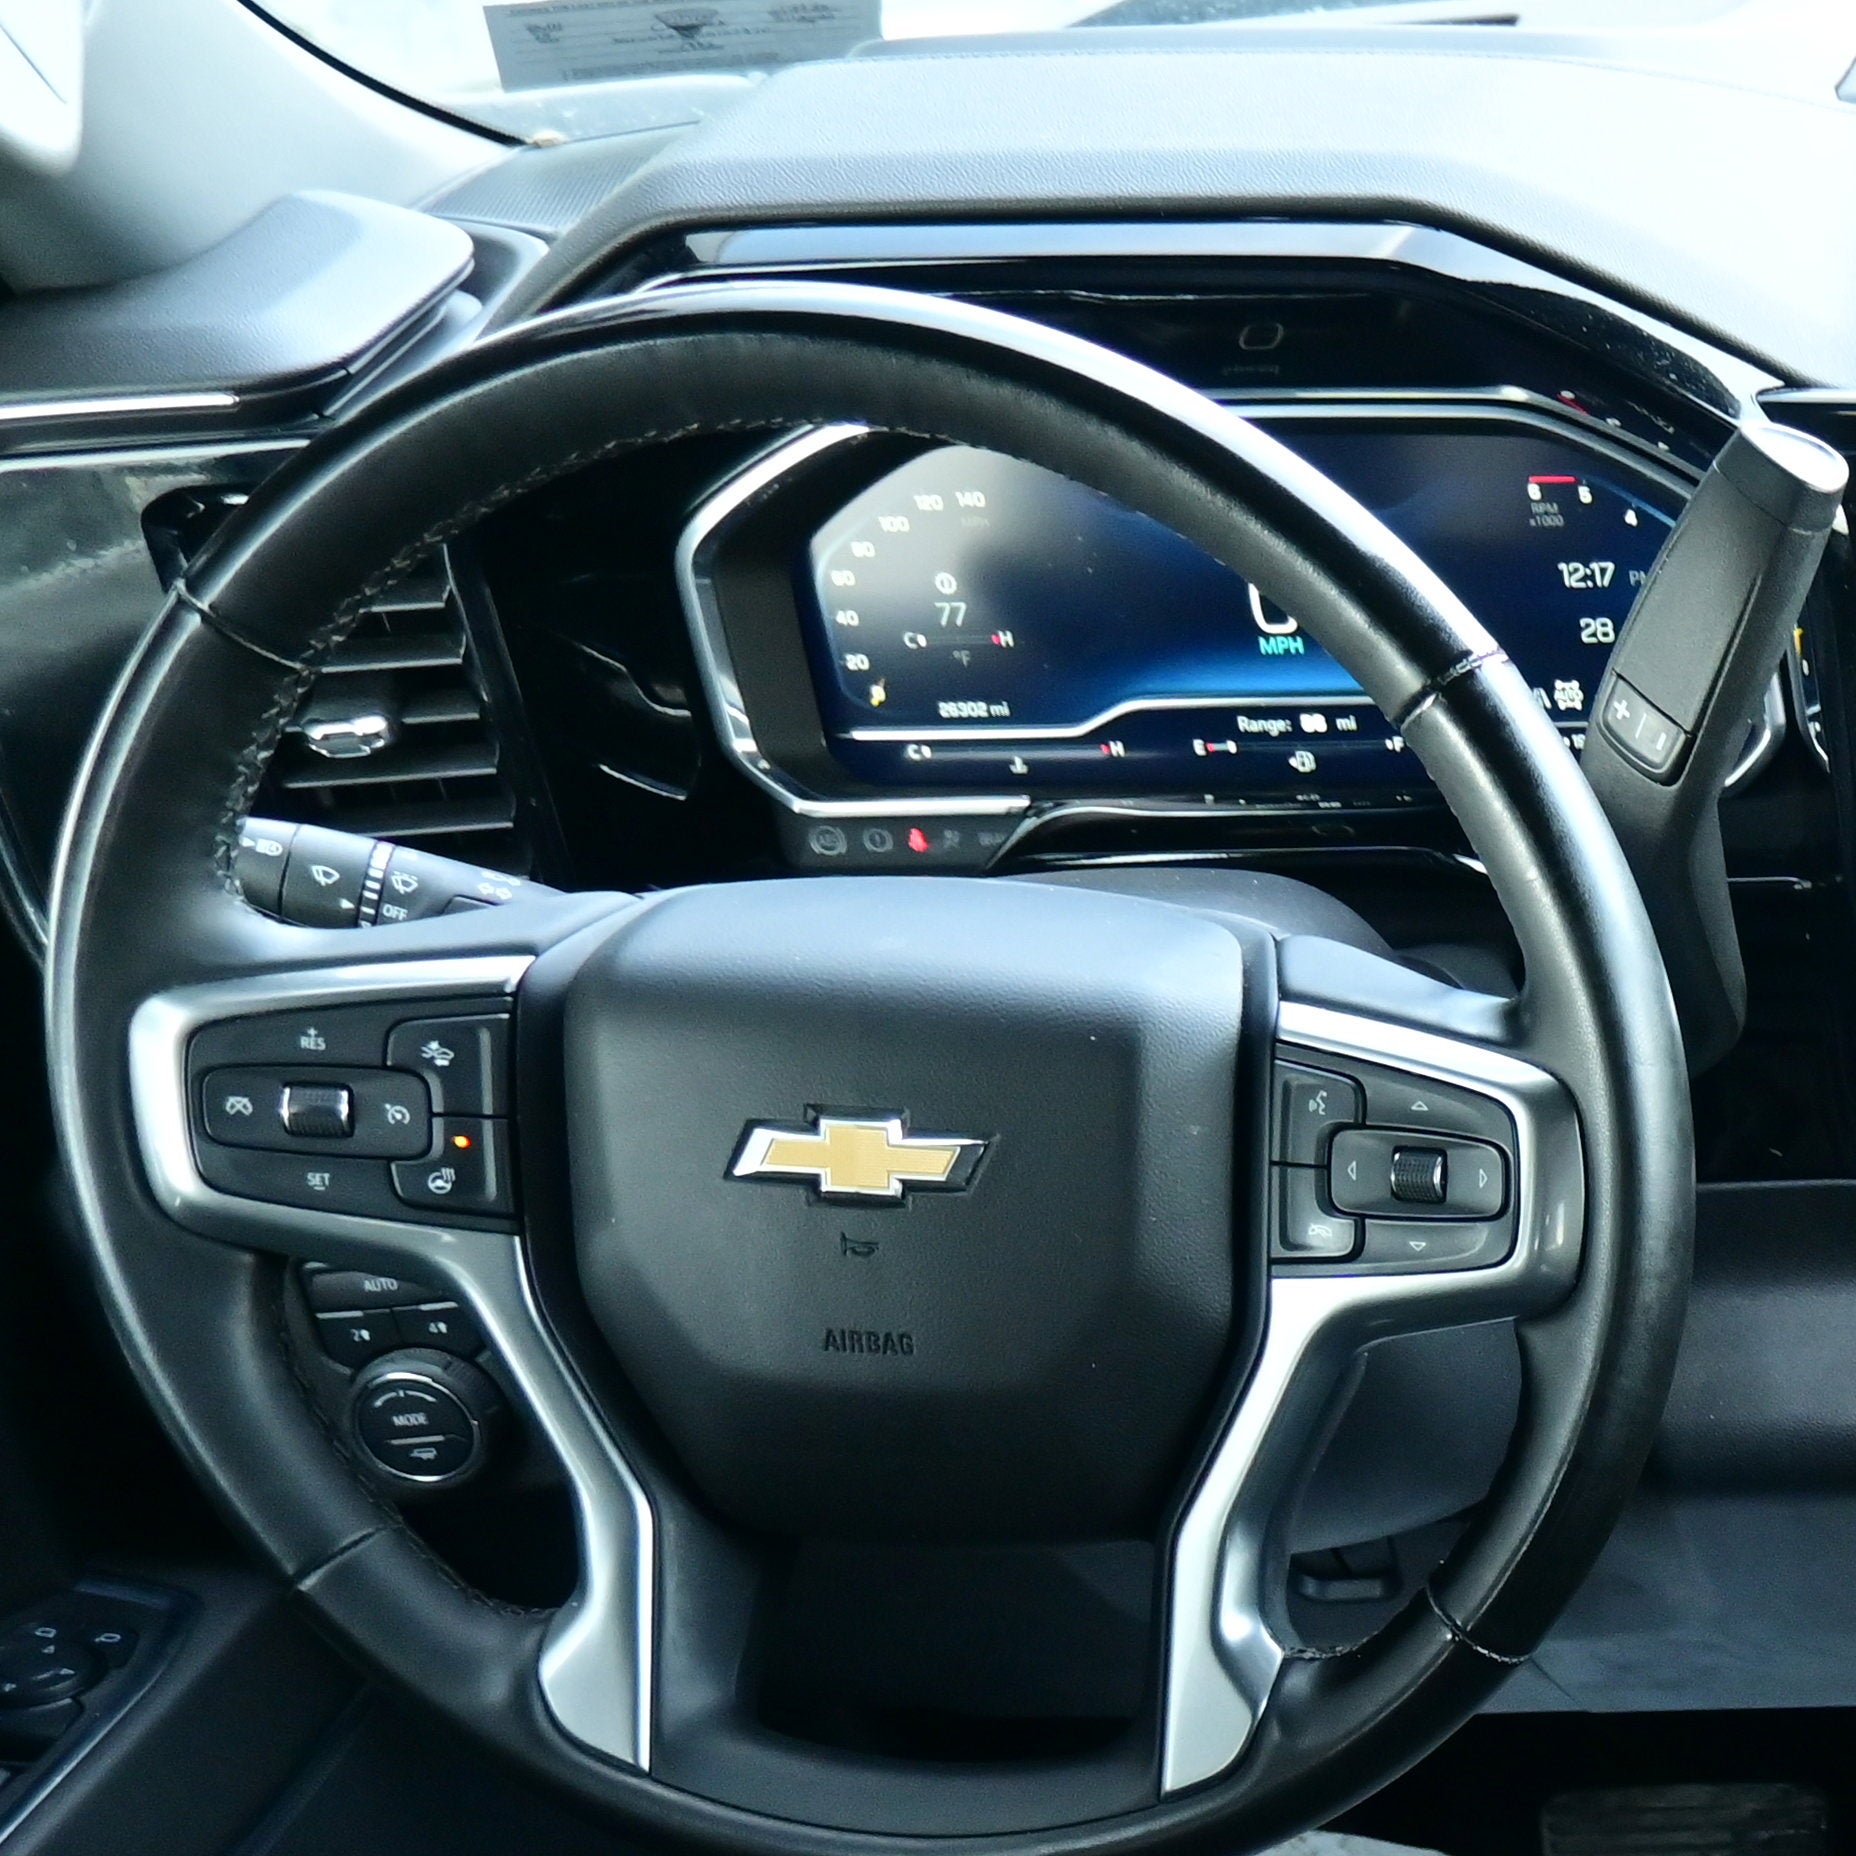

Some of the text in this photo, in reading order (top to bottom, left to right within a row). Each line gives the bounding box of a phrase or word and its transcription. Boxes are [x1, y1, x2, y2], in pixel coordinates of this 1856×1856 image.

[956, 491, 986, 507] 140
[1530, 502, 1558, 514] RPM
[879, 516, 910, 532] 100
[1557, 562, 1615, 588] 12:17
[836, 610, 859, 626] 40
[935, 602, 967, 627] 77
[998, 630, 1014, 648] H
[1579, 617, 1615, 644] 28
[1258, 636, 1304, 655] MPH
[845, 653, 870, 671] 20
[990, 701, 1011, 717] mi
[1236, 715, 1293, 737] Range:
[1335, 715, 1358, 731] mi
[1108, 740, 1126, 757] H
[382, 903, 408, 920] OFF
[301, 1036, 326, 1050] RES
[307, 1172, 330, 1186] SET
[363, 1278, 398, 1292] AUTO
[823, 1327, 915, 1357] AIRBAG
[391, 1412, 429, 1426] MODE
